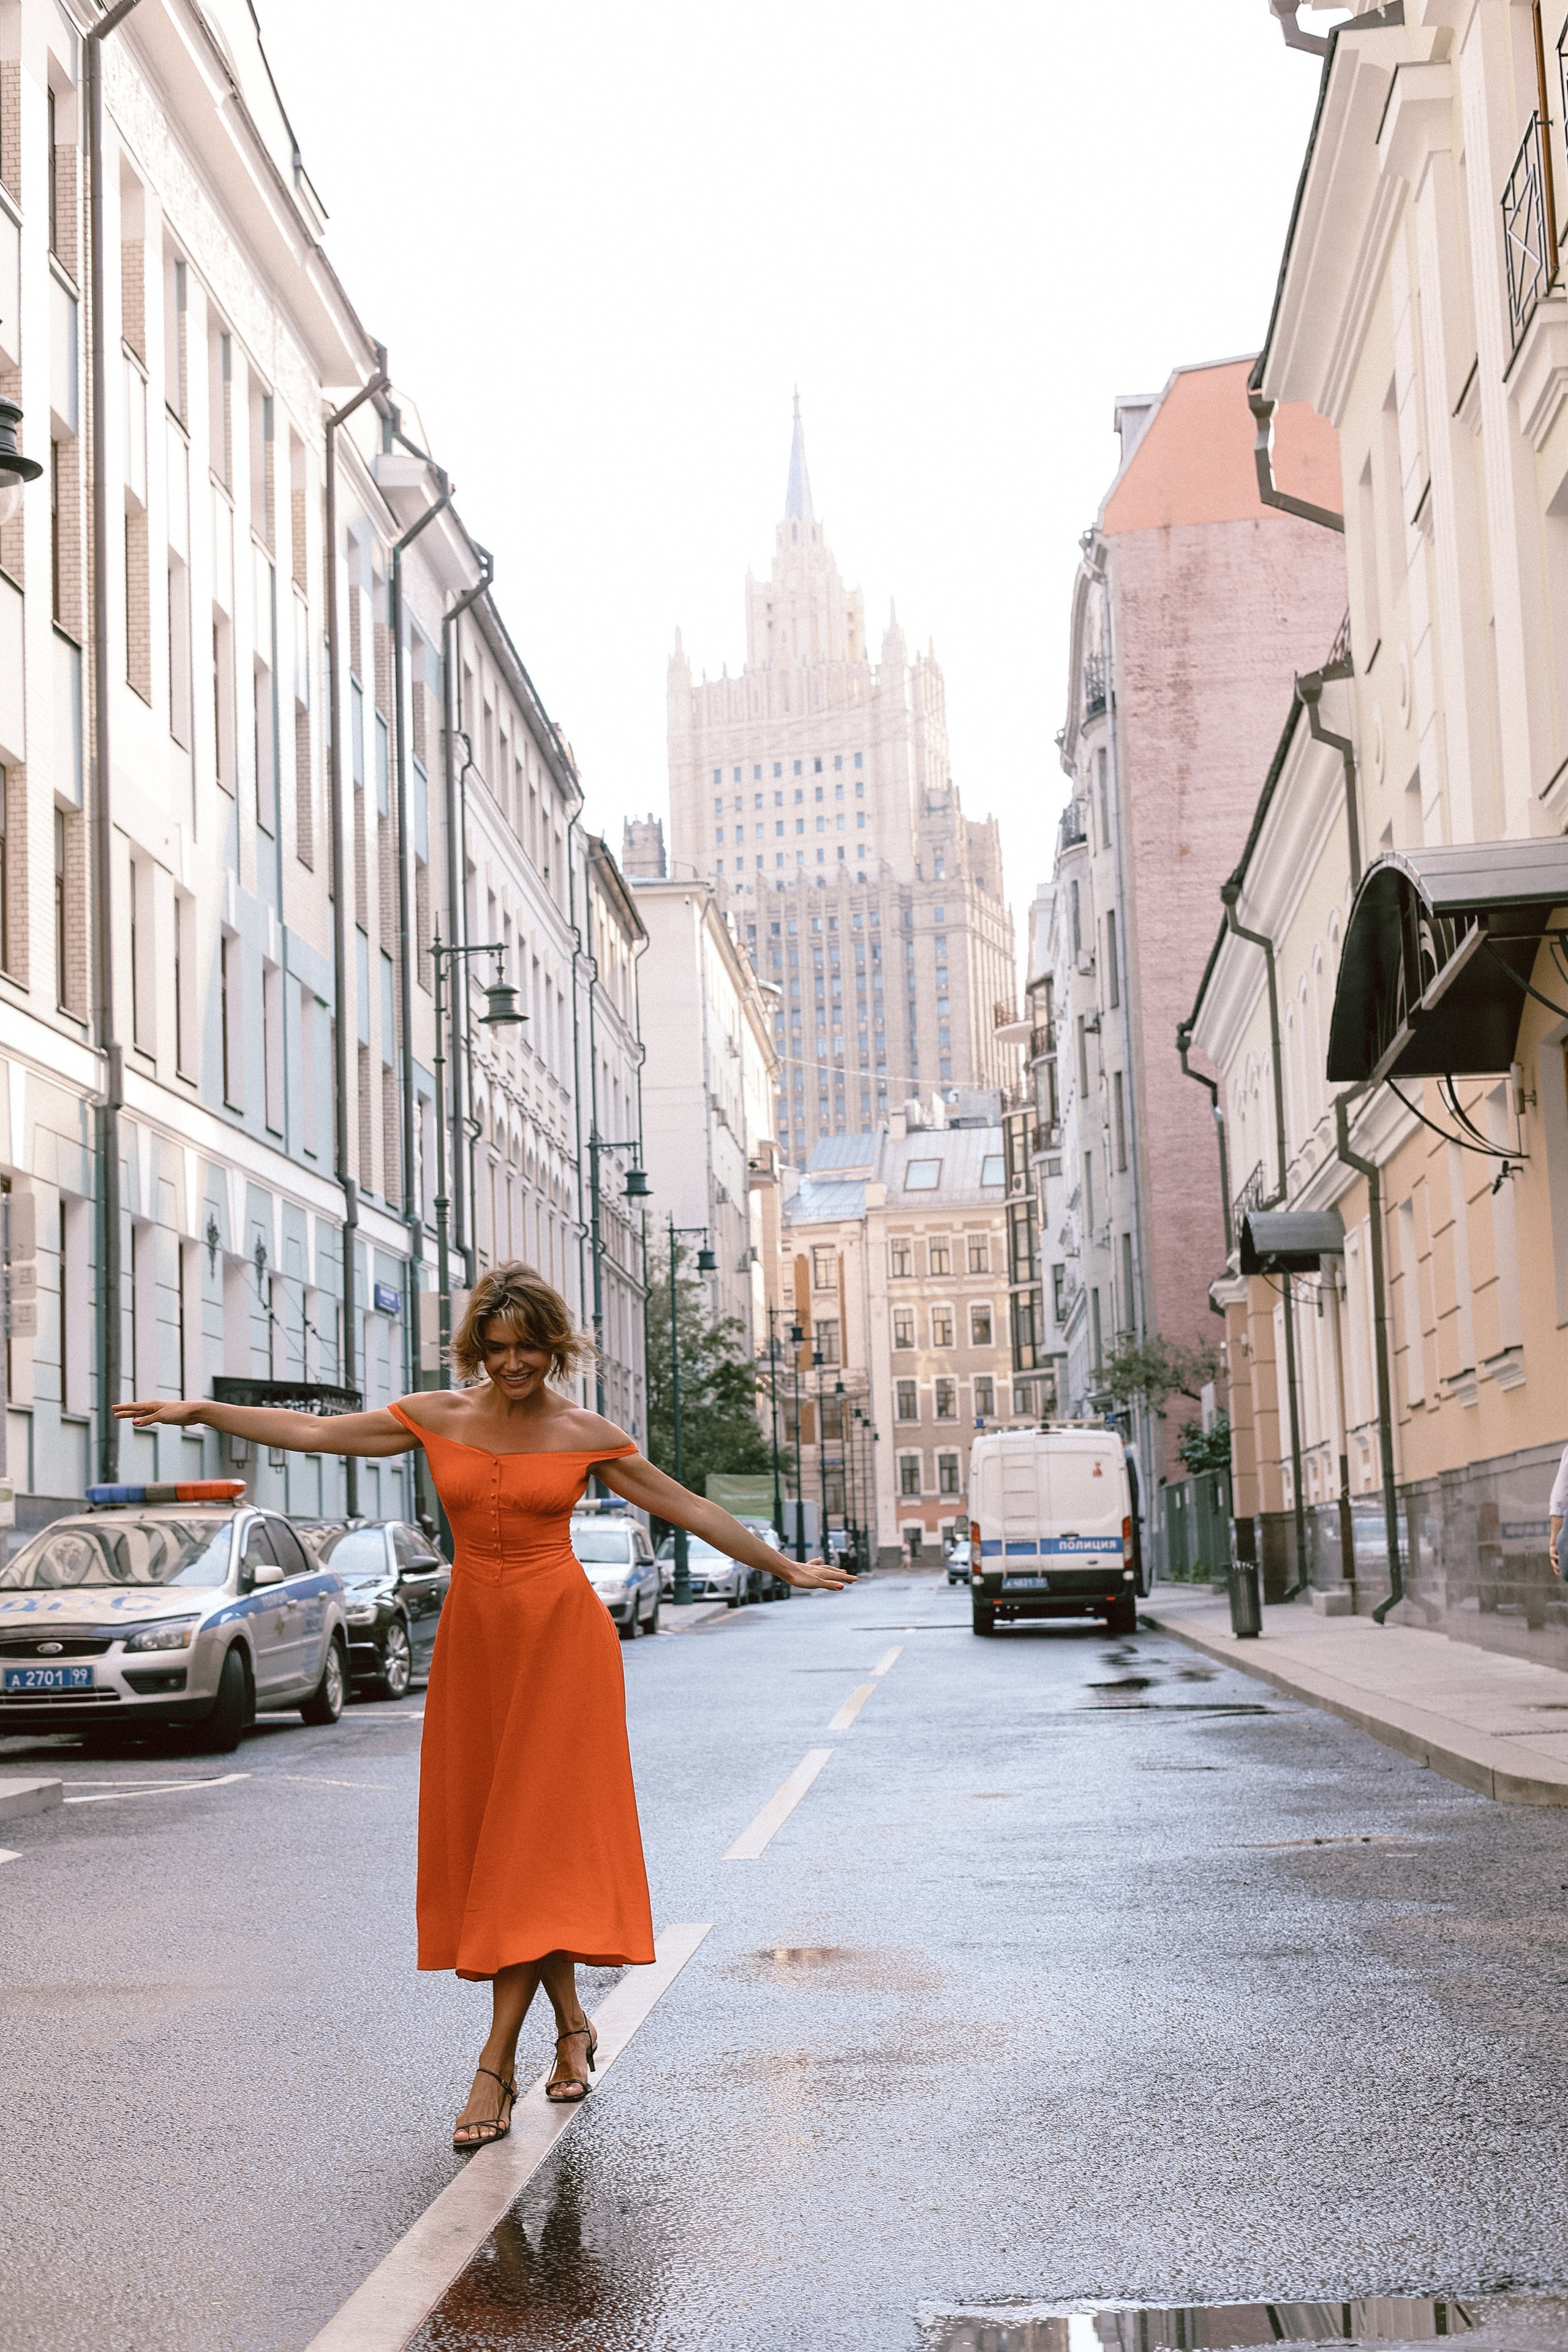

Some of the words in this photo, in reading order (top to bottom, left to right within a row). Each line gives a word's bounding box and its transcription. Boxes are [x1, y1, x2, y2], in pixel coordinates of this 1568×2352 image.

[1058, 1540, 1117, 1551] ПОЛИЦИЯ
[25, 1670, 63, 1686] 2701
[72, 1668, 88, 1681] 99
